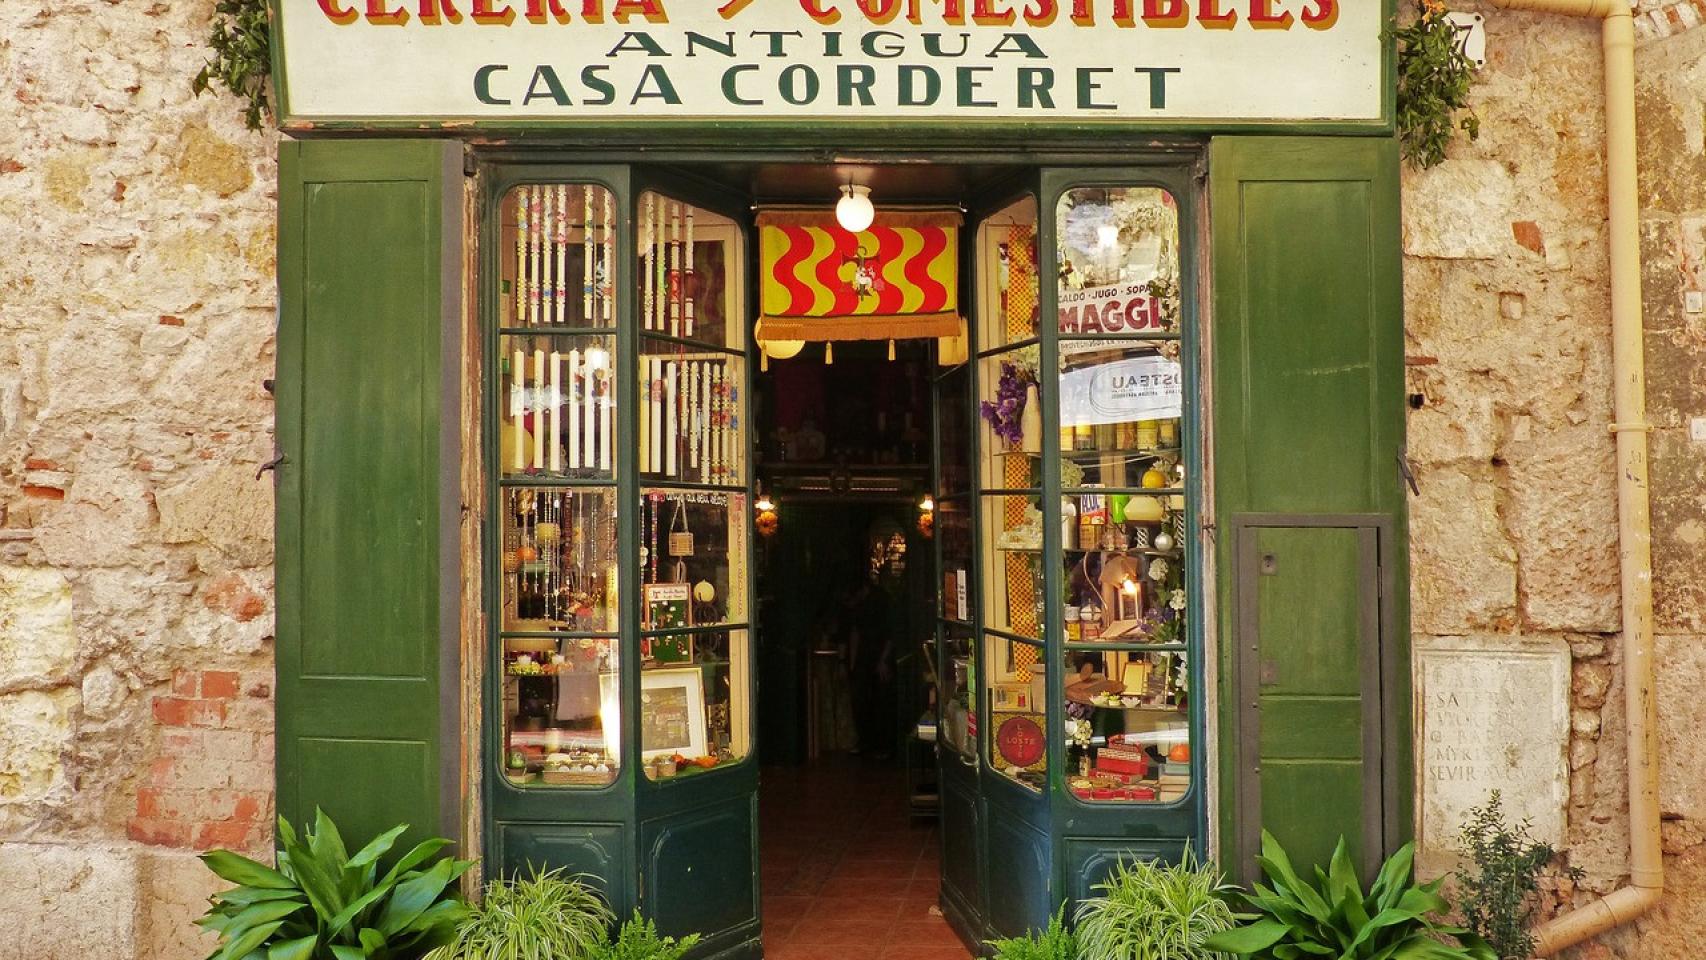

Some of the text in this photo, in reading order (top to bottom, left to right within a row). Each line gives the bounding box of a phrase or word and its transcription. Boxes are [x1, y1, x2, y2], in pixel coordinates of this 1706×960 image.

[606, 31, 1048, 58] ANTIGUA
[474, 64, 1181, 109] CASA CORDERET
[1092, 289, 1118, 299] JUGO
[1058, 296, 1162, 334] MAGGI
